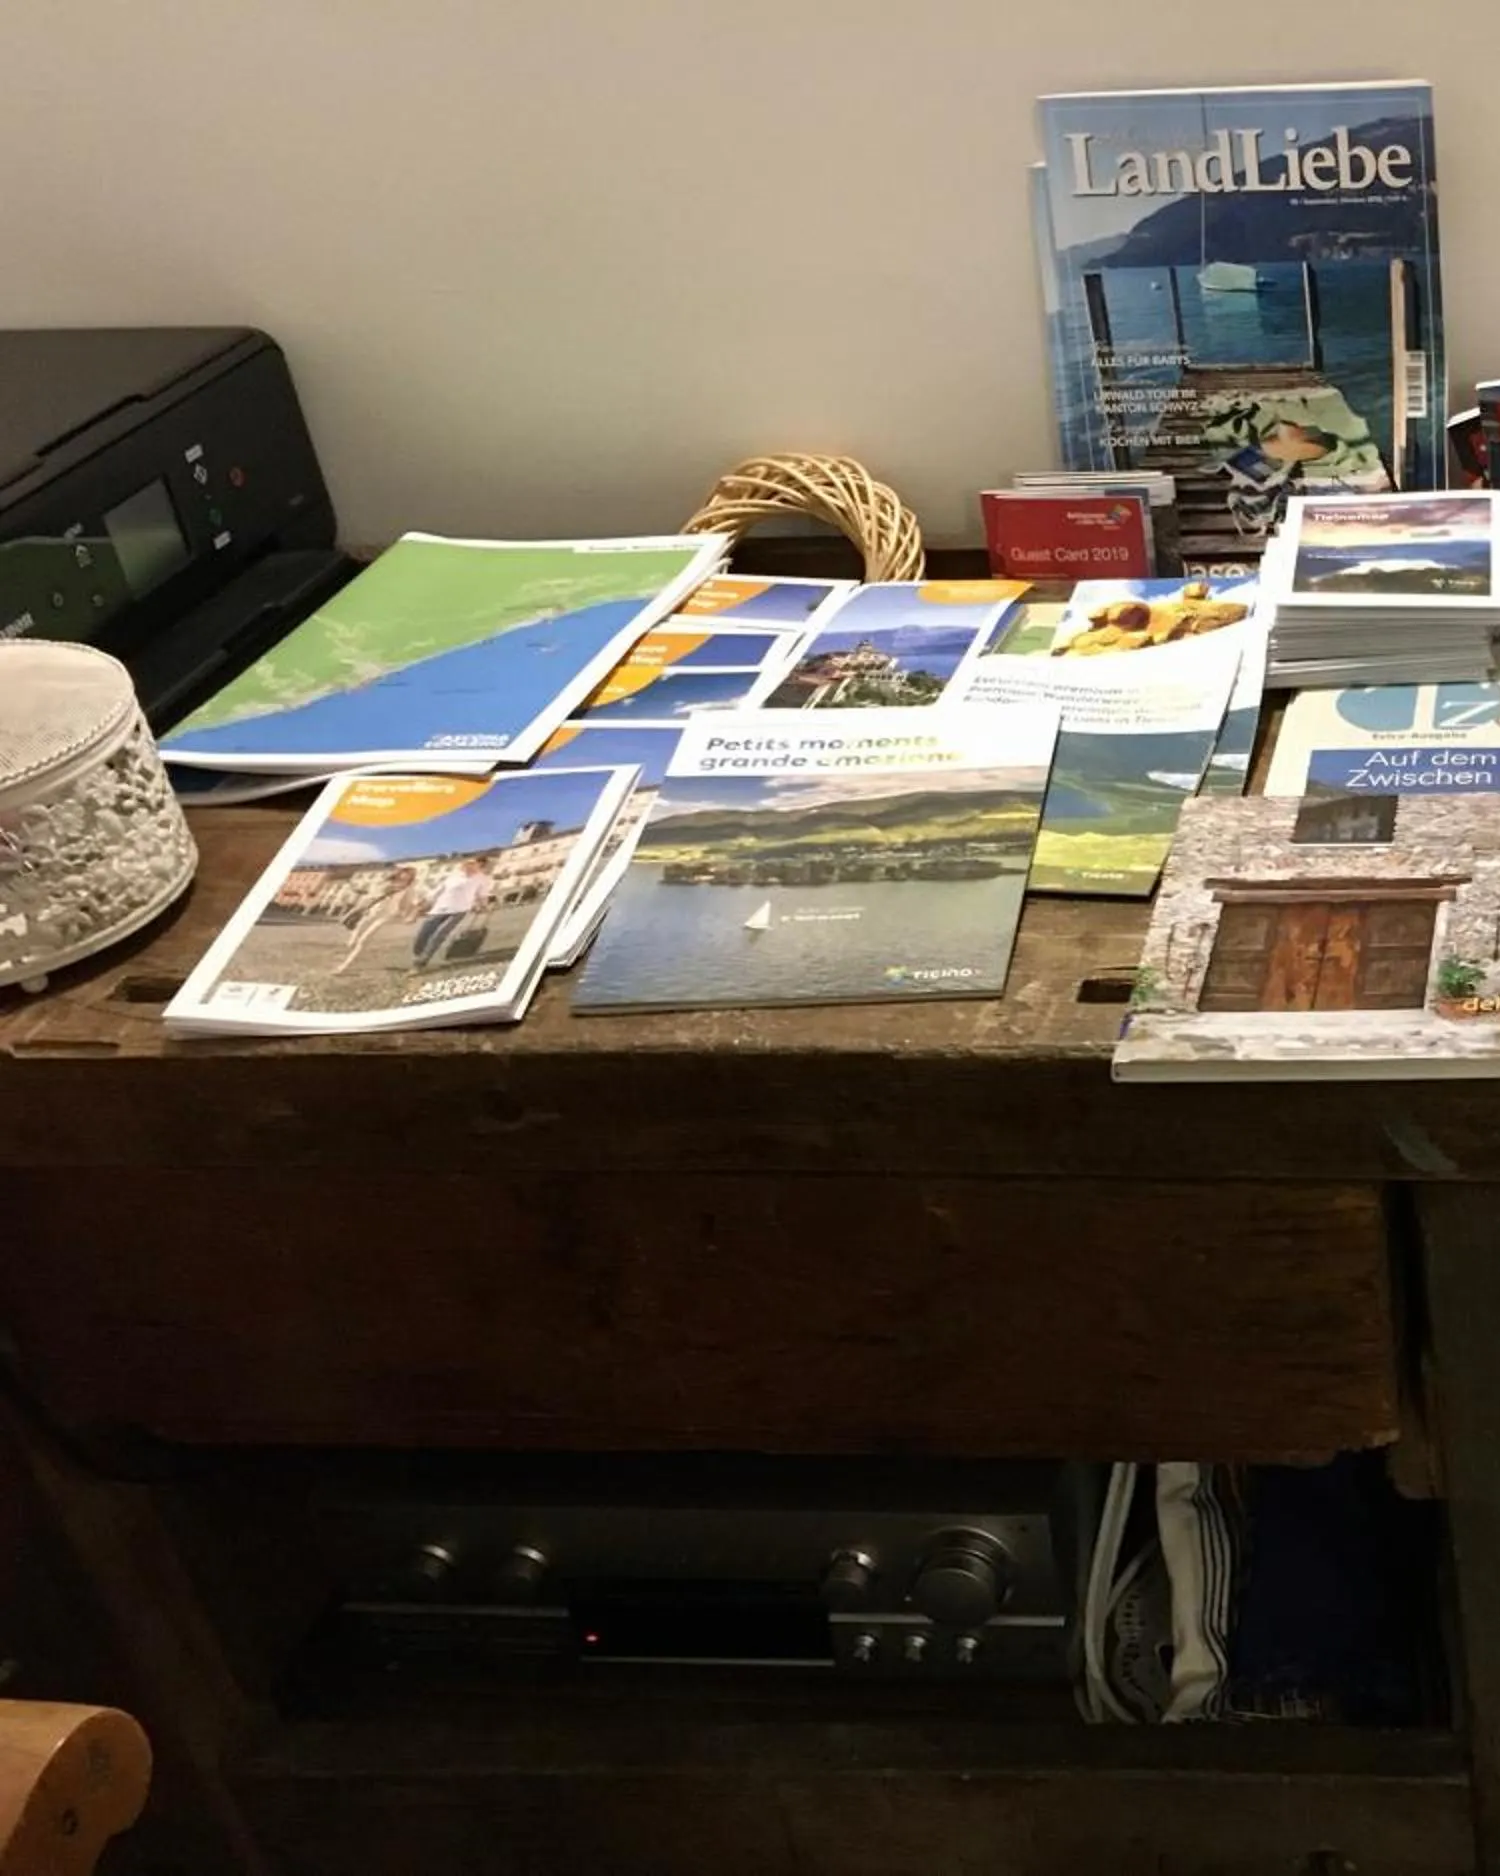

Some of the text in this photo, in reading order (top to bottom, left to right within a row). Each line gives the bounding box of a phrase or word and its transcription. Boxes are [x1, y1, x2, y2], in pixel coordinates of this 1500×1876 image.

[1065, 126, 1414, 198] LandLiebe
[1010, 546, 1129, 562] Guest Card 2019
[706, 737, 790, 751] Petits
[700, 753, 808, 771] grande
[1365, 750, 1420, 767] Auf
[1431, 750, 1497, 766] dem
[1345, 768, 1492, 787] Zwischen
